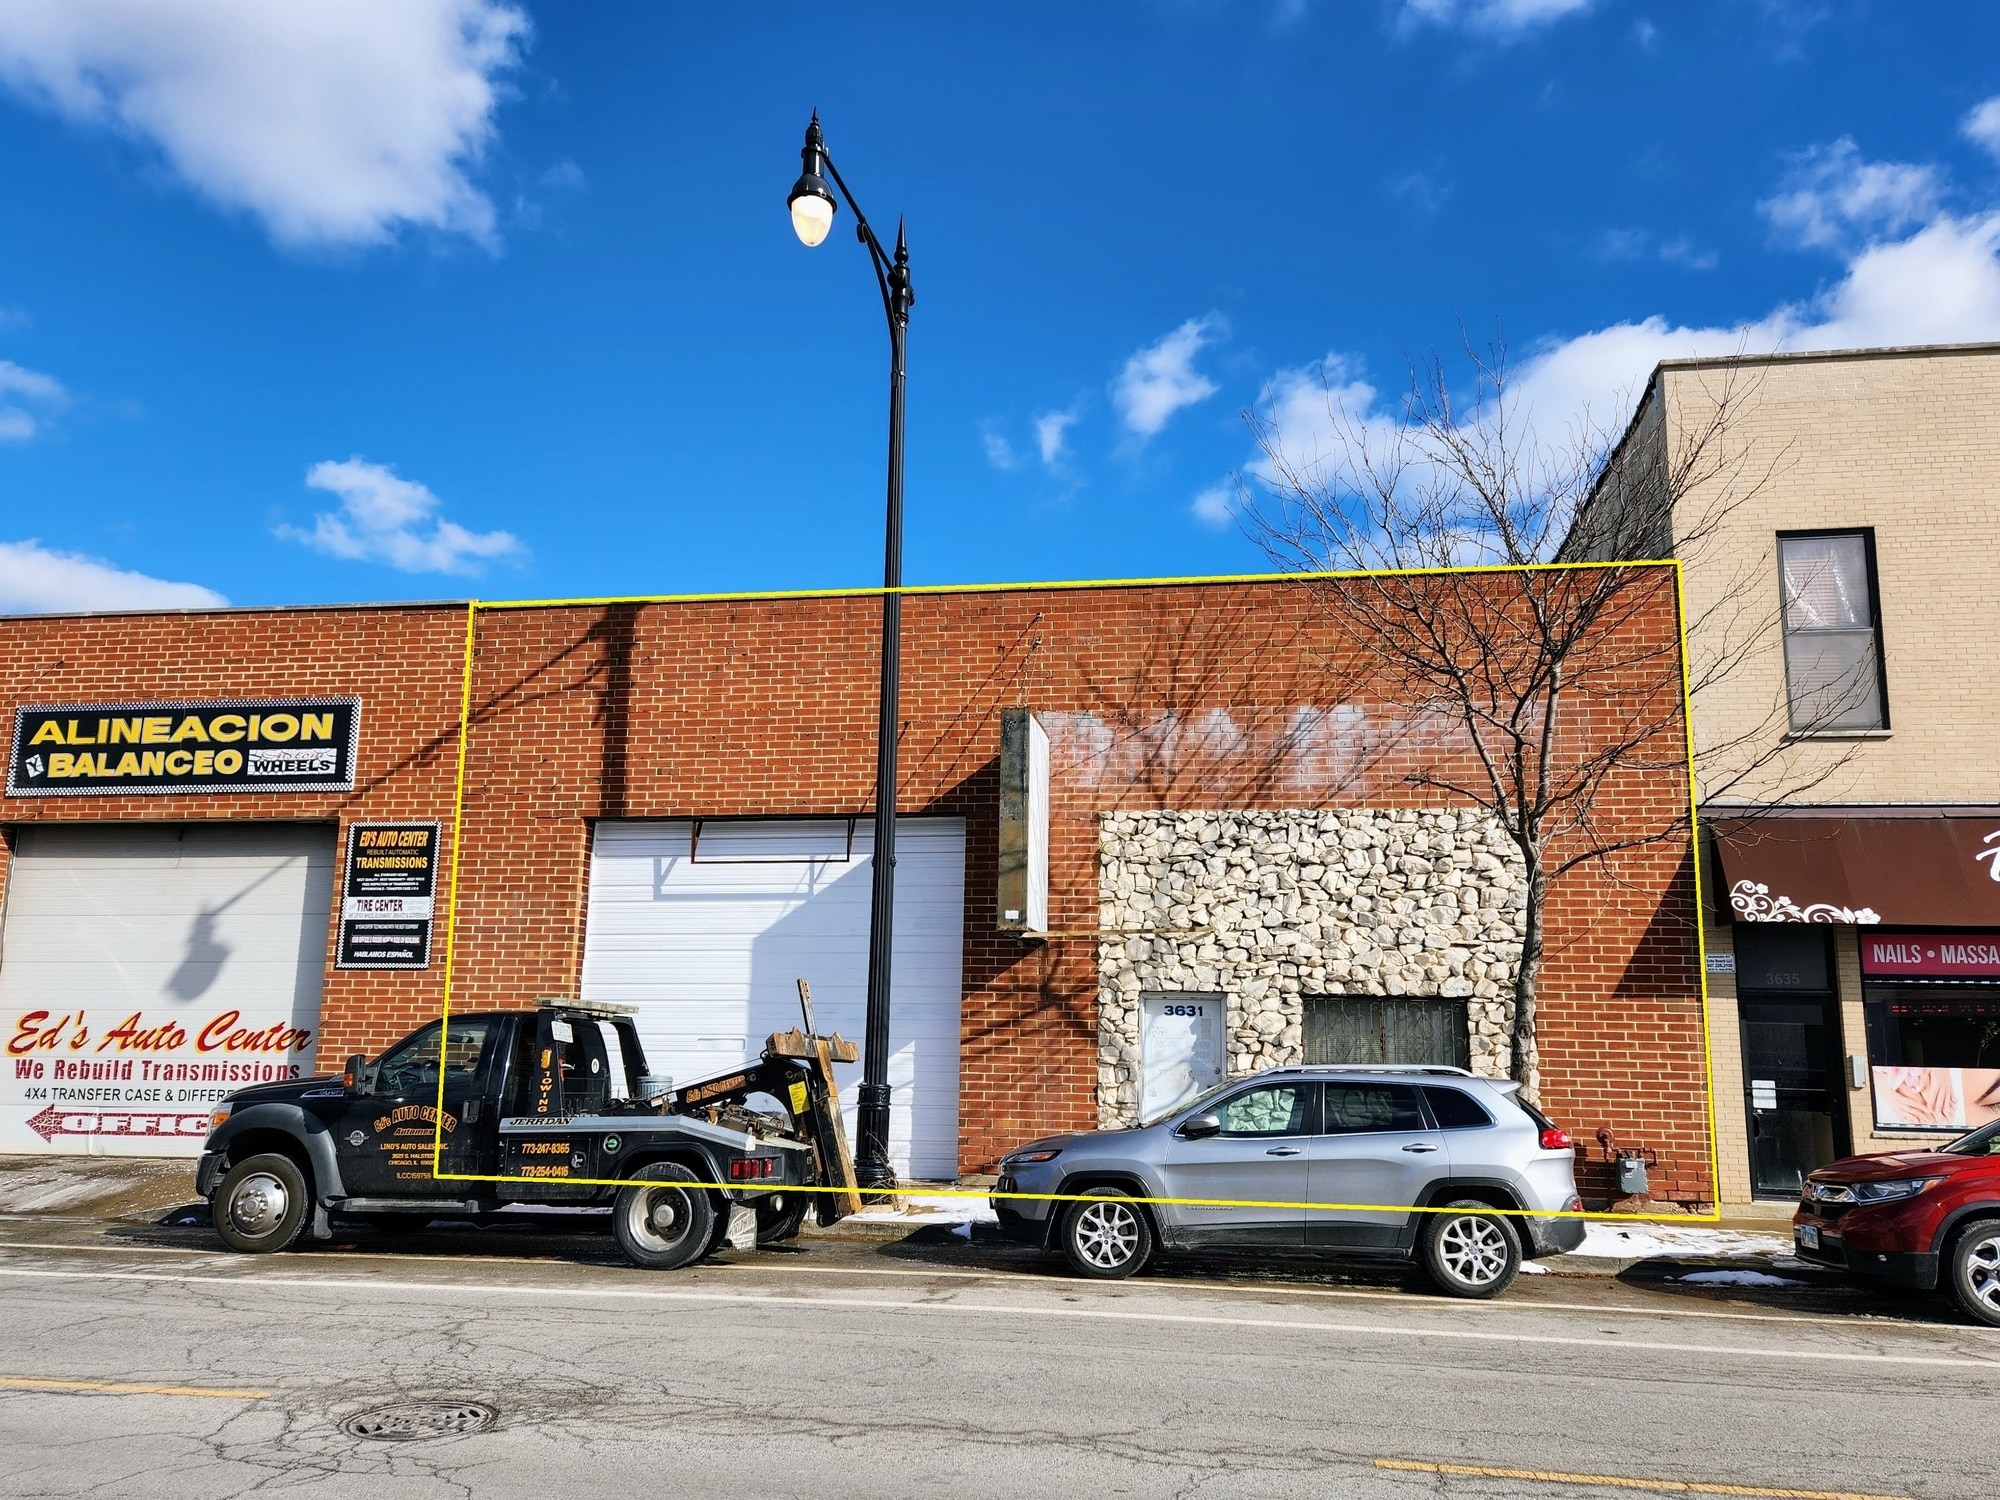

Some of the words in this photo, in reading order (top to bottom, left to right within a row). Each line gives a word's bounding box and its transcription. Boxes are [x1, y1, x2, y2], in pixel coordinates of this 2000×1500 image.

[28, 713, 334, 745] ALINEACION
[47, 749, 243, 778] BALANCEO
[254, 760, 330, 772] WHEELS
[359, 831, 377, 847] ED'S
[376, 831, 398, 847] AUTO
[398, 831, 429, 847] CENTER
[356, 857, 428, 868] TRANSMISSIONS
[357, 900, 373, 911] TIRE
[375, 900, 403, 911] CENTER
[386, 949, 414, 958] ESPAÑOL
[1873, 944, 1921, 963] NAILS
[1766, 973, 1800, 985] 3635
[1164, 1005, 1203, 1016] 3631
[6, 1010, 90, 1057] Ed's
[96, 1012, 188, 1053] Auto
[194, 1010, 313, 1055] Center
[15, 1059, 44, 1079] We
[54, 1059, 133, 1081] Rebuild
[142, 1060, 300, 1082] Transmissions
[24, 1087, 47, 1099] 4X4
[52, 1088, 120, 1101] TRANSFER
[125, 1089, 161, 1101] CASE
[165, 1090, 173, 1101] &
[537, 1071, 552, 1113] TOWING
[392, 1105, 419, 1124] AUTO
[521, 1143, 570, 1153] 773-247-8365
[521, 1166, 568, 1176] 773-254-0416
